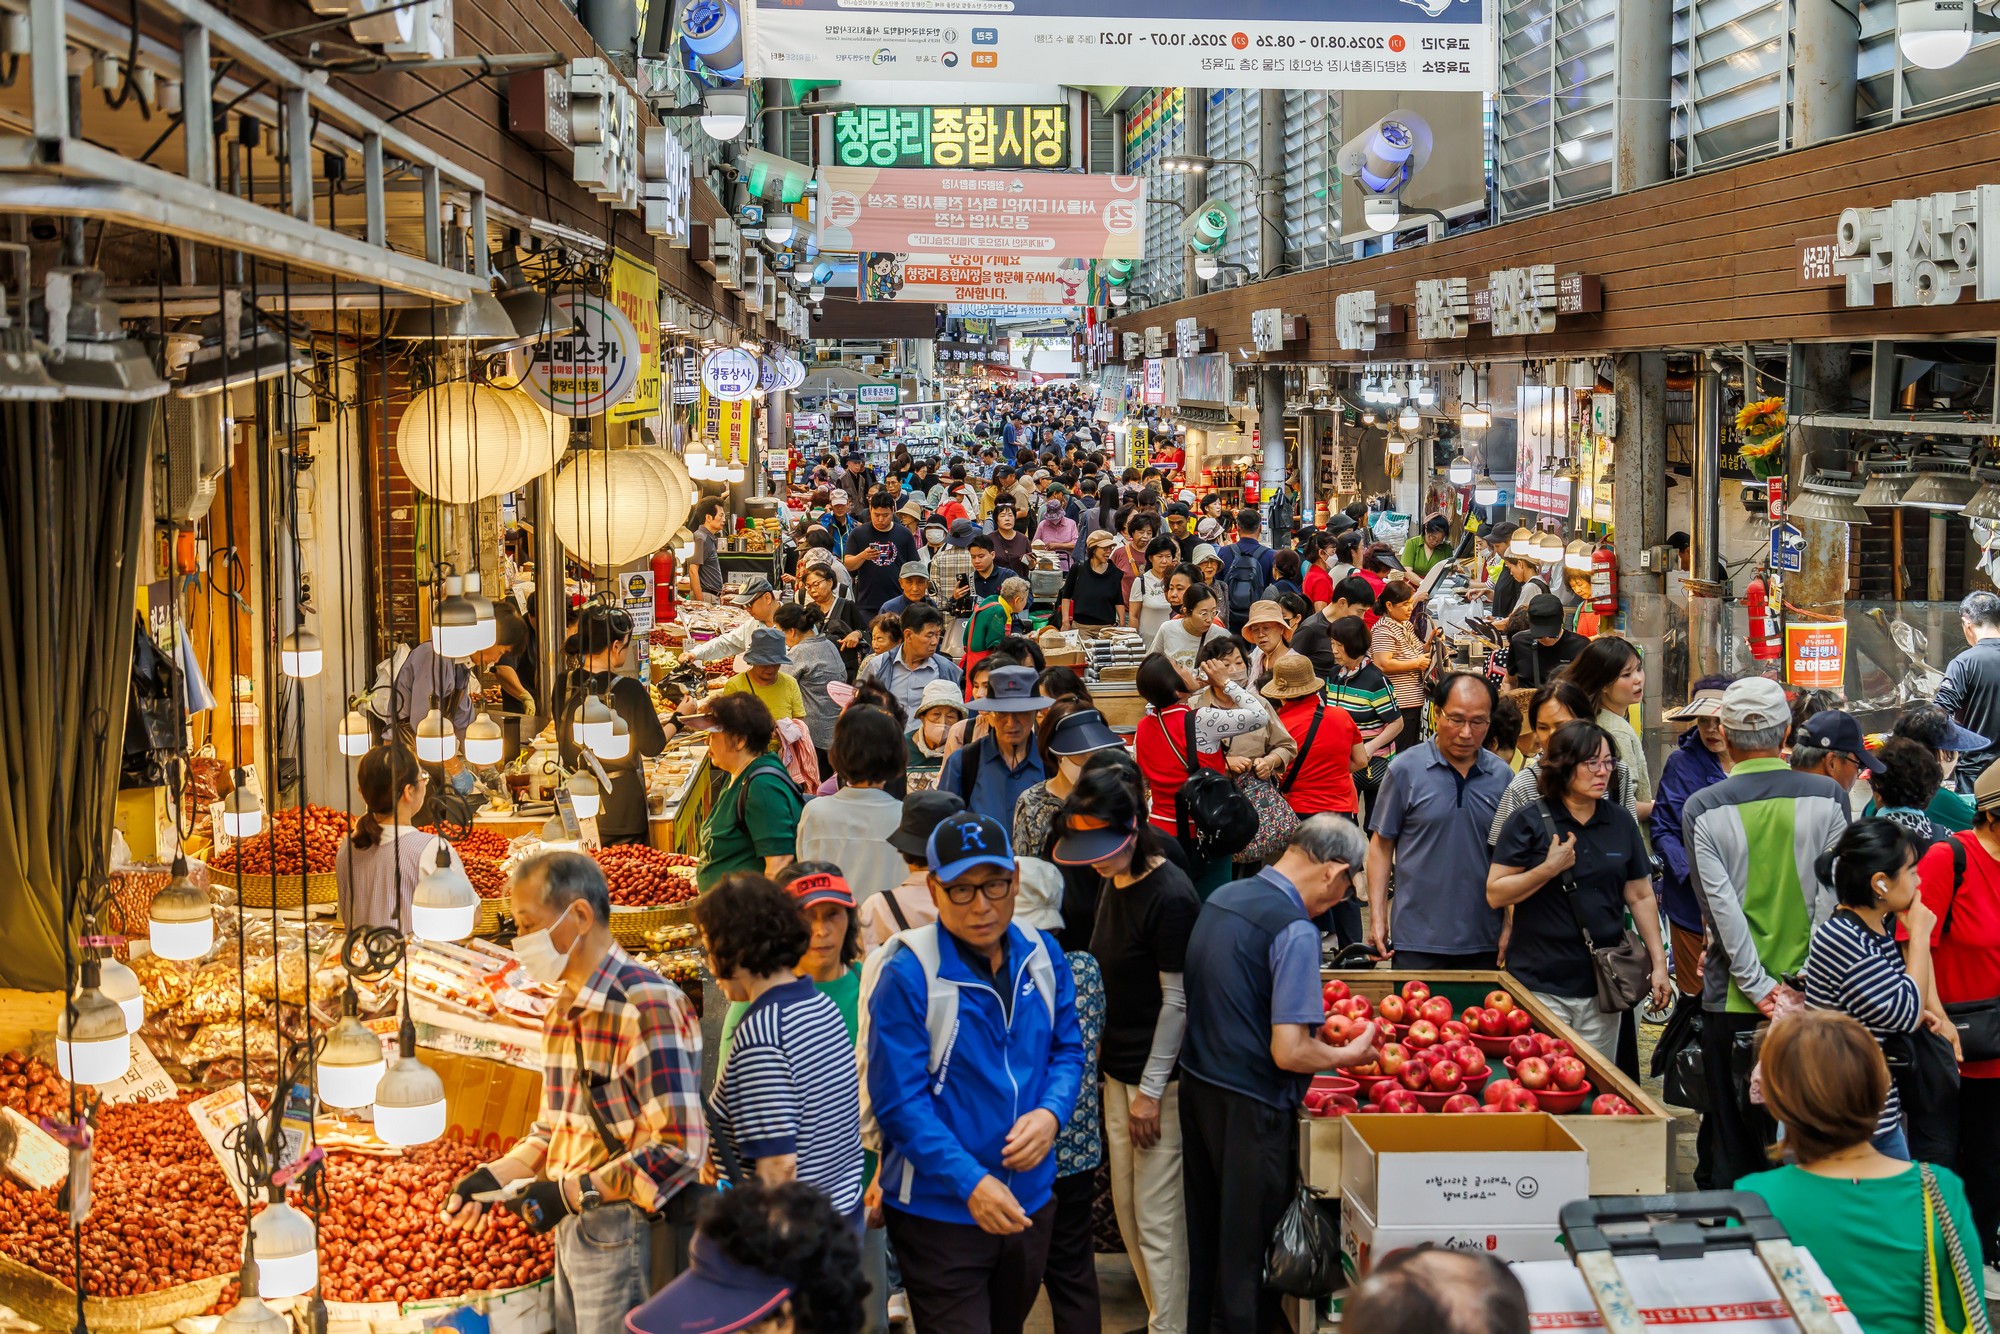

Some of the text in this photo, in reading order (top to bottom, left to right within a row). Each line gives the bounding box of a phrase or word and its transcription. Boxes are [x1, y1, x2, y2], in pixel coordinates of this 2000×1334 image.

[836, 107, 1065, 166] 청량리종합시장
[906, 267, 1056, 285] 청량리 종합시장을 방문해 주셔서
[954, 286, 1008, 300] 감사합니다.
[710, 367, 751, 381] 경동상사
[1133, 429, 1146, 469] 홍어무침
[1794, 659, 1840, 672] 참여점포
[955, 820, 988, 851] R
